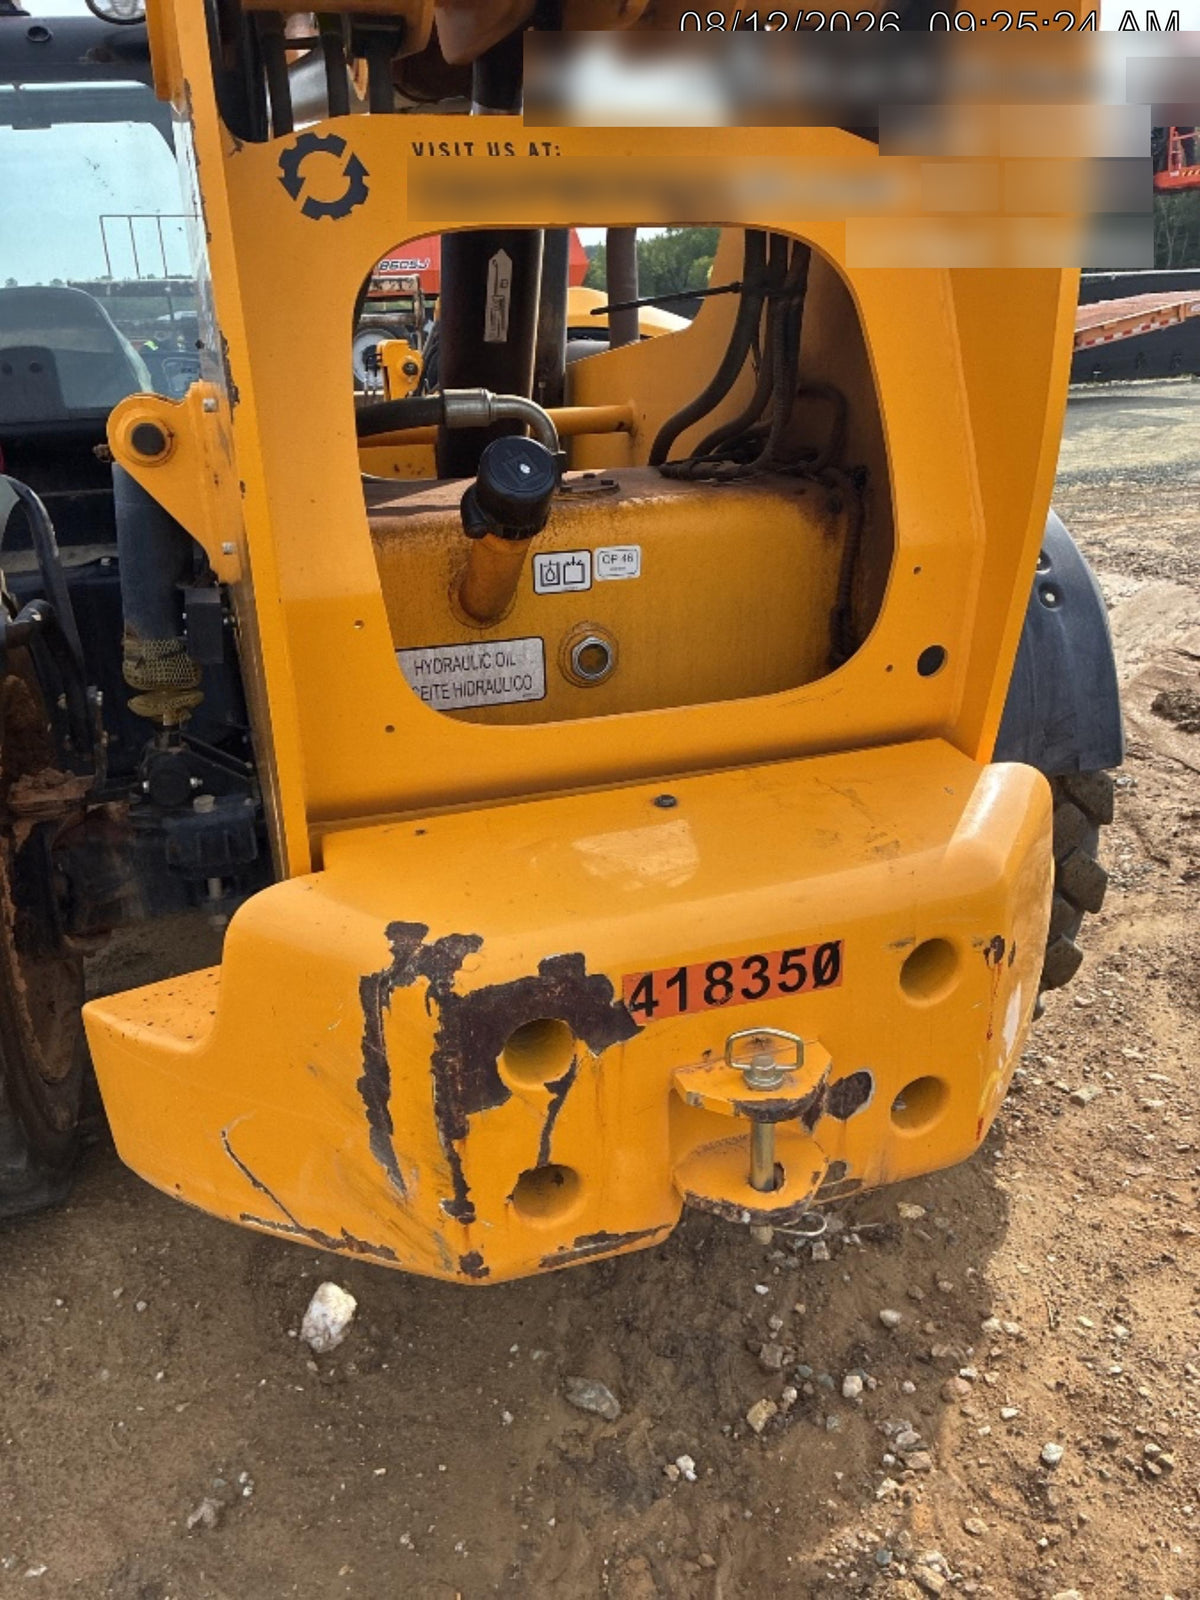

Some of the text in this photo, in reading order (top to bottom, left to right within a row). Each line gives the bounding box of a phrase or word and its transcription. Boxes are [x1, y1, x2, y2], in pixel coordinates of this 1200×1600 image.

[411, 142, 561, 156] VISIT US AT:
[414, 652, 517, 676] HYDRAULIC OIL
[453, 674, 533, 699] HIDRAULICO
[629, 940, 842, 1017] 418350
